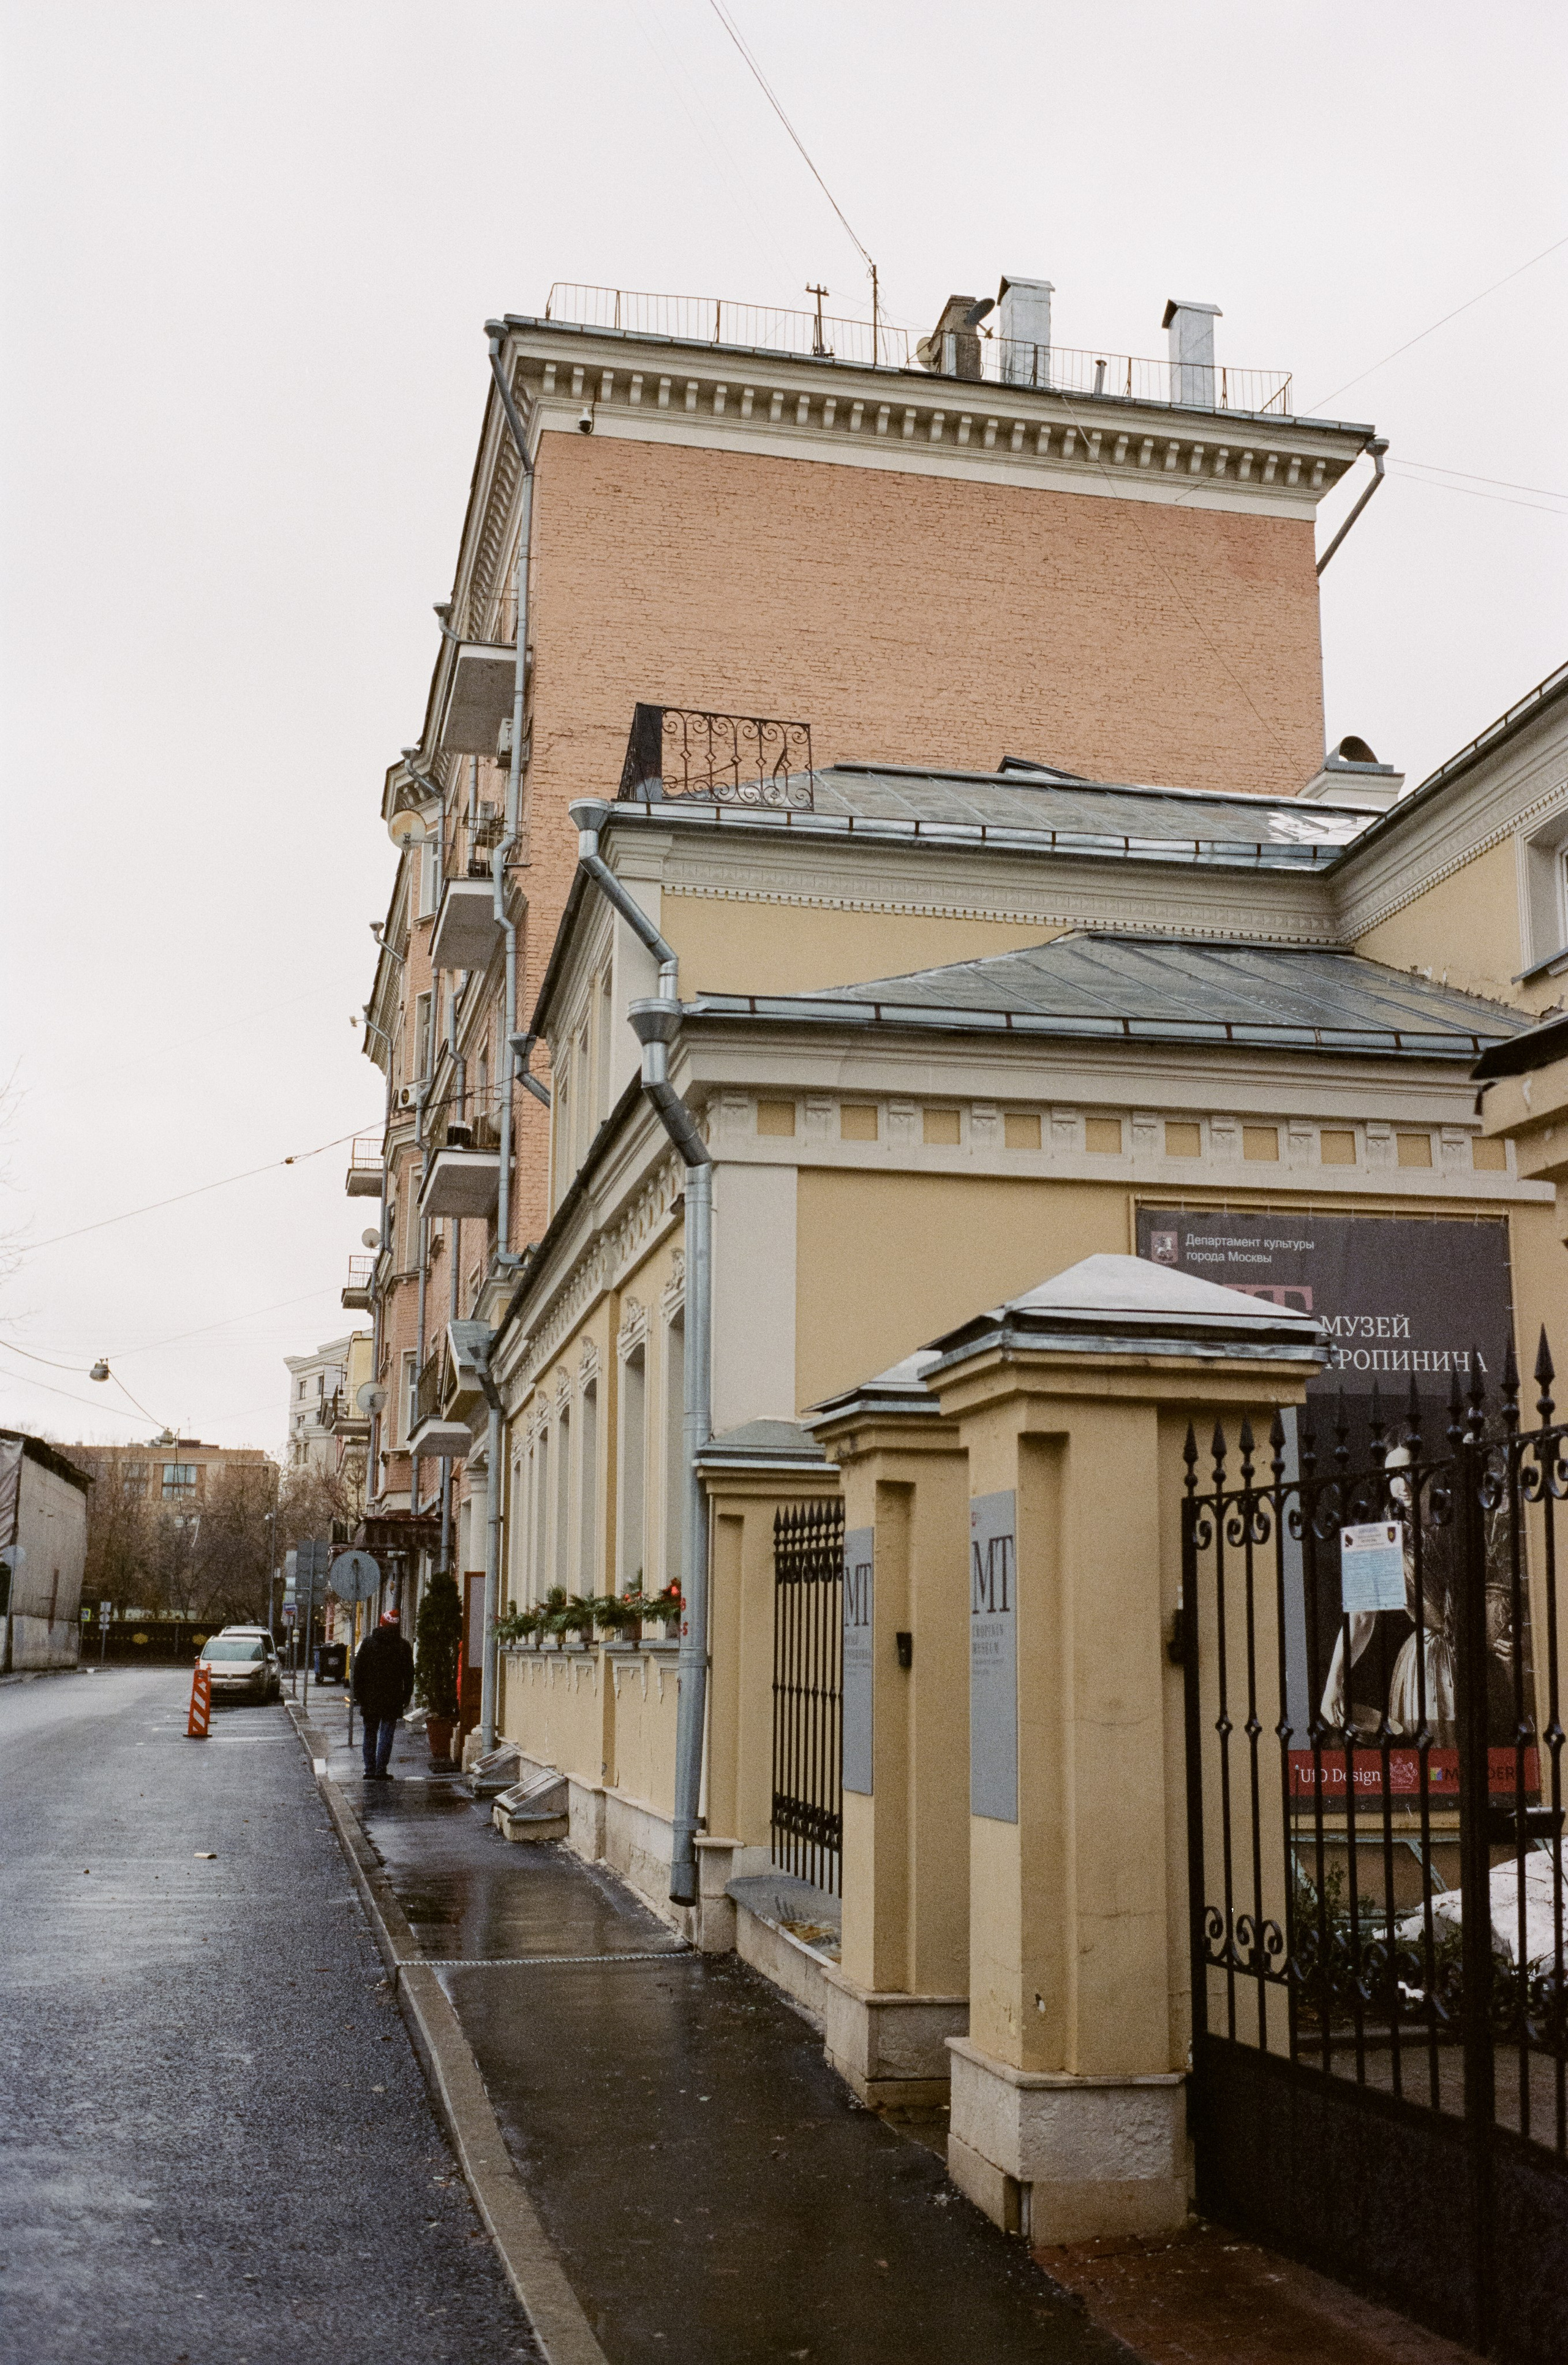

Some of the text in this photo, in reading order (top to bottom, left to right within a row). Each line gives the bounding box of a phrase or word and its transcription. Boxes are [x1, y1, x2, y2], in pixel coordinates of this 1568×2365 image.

[1185, 1233, 1314, 1251] Департамент культуры
[1186, 1251, 1272, 1263] города Москвы
[1321, 1314, 1411, 1338] МУЗЕЙ
[1324, 1349, 1488, 1372] РОПИНИНА
